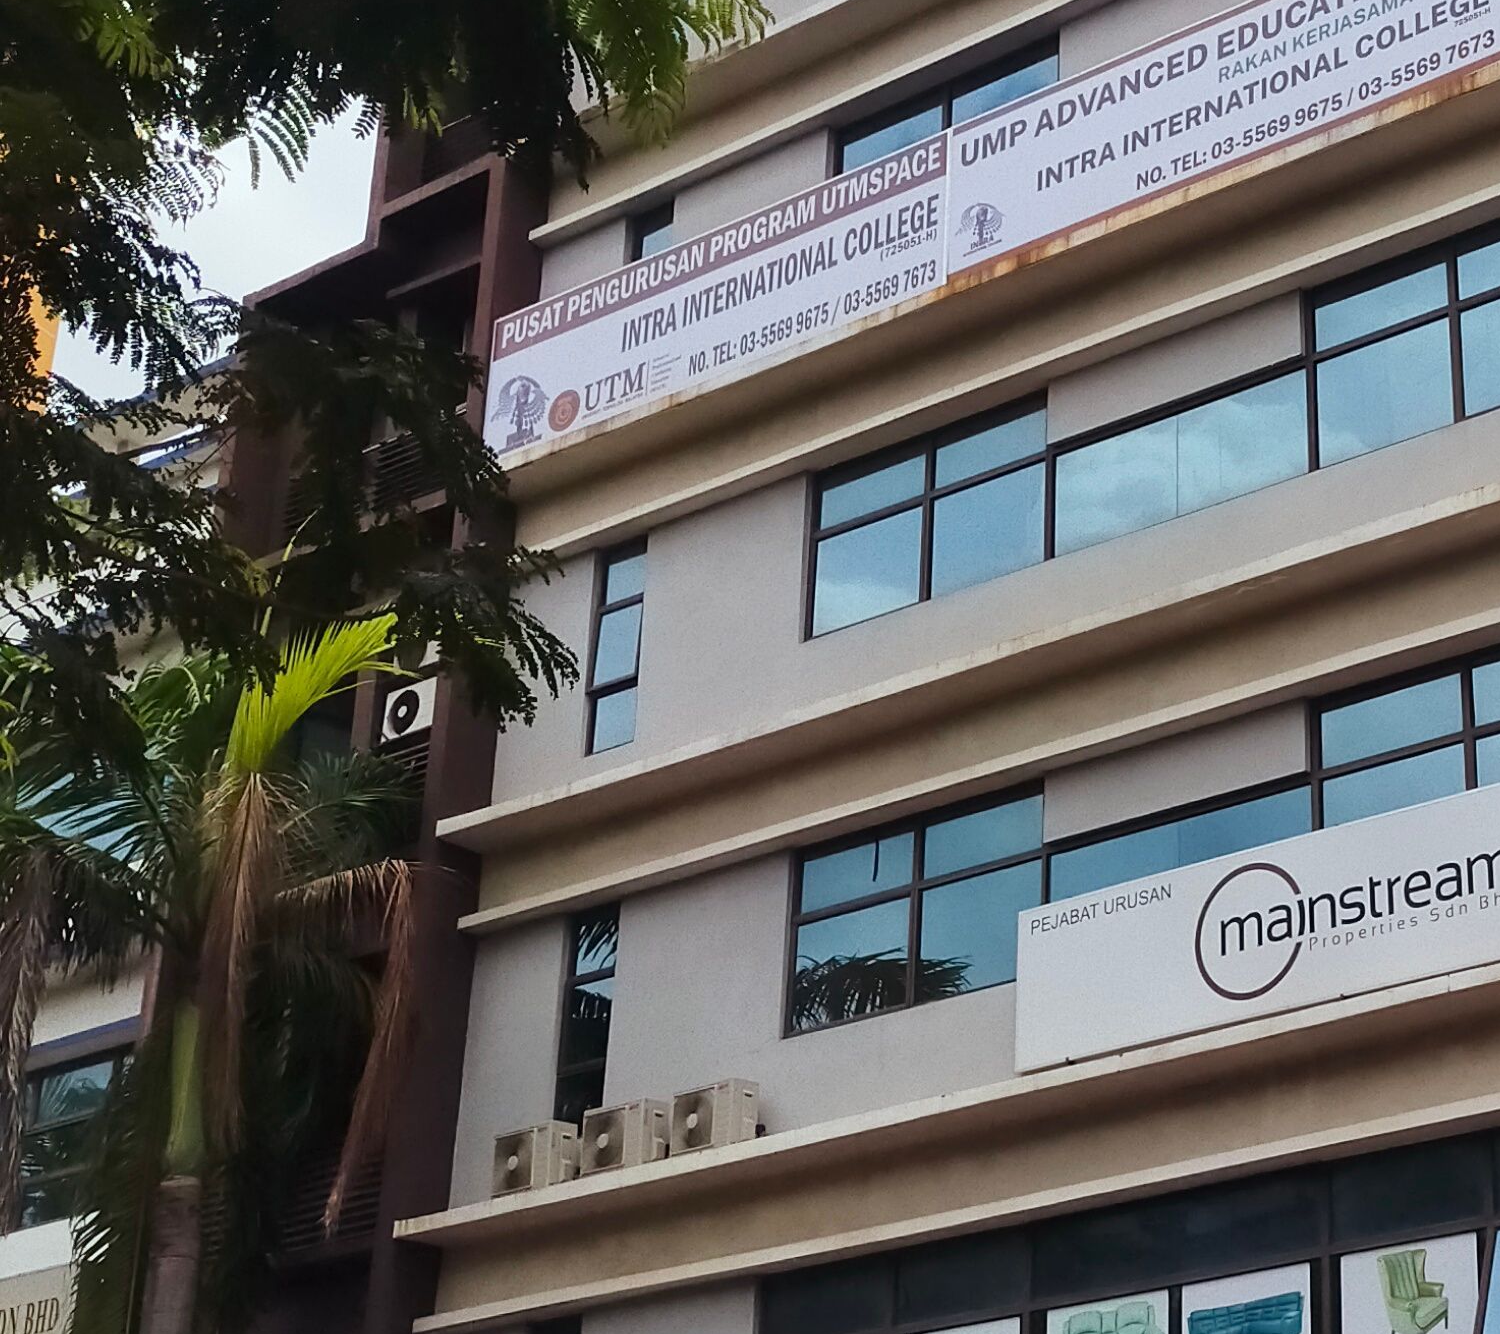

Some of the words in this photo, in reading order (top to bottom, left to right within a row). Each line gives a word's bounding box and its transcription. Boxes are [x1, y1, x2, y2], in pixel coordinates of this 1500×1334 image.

[960, 119, 1027, 168] UMP
[1035, 43, 1209, 138] ADVANCED
[1036, 143, 1116, 193] INTRA
[1122, 51, 1349, 164] INTERNATIONAL
[1136, 164, 1168, 191] NO.
[1171, 149, 1207, 180] TEL:
[1211, 114, 1291, 161] 03-5569
[1294, 92, 1344, 135] 9675
[1346, 87, 1355, 114] /
[1358, 51, 1442, 103] 03-5569
[1446, 28, 1496, 73] 7673
[1218, 46, 1288, 84] RAKAN
[501, 311, 563, 351] PUSAT
[567, 245, 706, 323] PENGURUSAN
[709, 199, 816, 261] PROGRAM
[821, 141, 942, 214] UTMSPACE
[621, 303, 678, 353] INTRA
[682, 241, 838, 329] INTERNATIONAL
[844, 193, 941, 261] COLLEGE
[688, 351, 709, 377] NO.
[712, 340, 738, 369] TEL:
[740, 319, 794, 356] 03-5569
[796, 305, 830, 336] 9675
[831, 296, 841, 327] /
[844, 276, 900, 316] 03-5569
[903, 259, 937, 296] 7673
[584, 362, 646, 412] UTM
[1030, 903, 1099, 936] PEJABAT
[1103, 882, 1173, 917] URUSAN
[1307, 915, 1420, 952] Properties
[1430, 899, 1469, 923] Sdn
